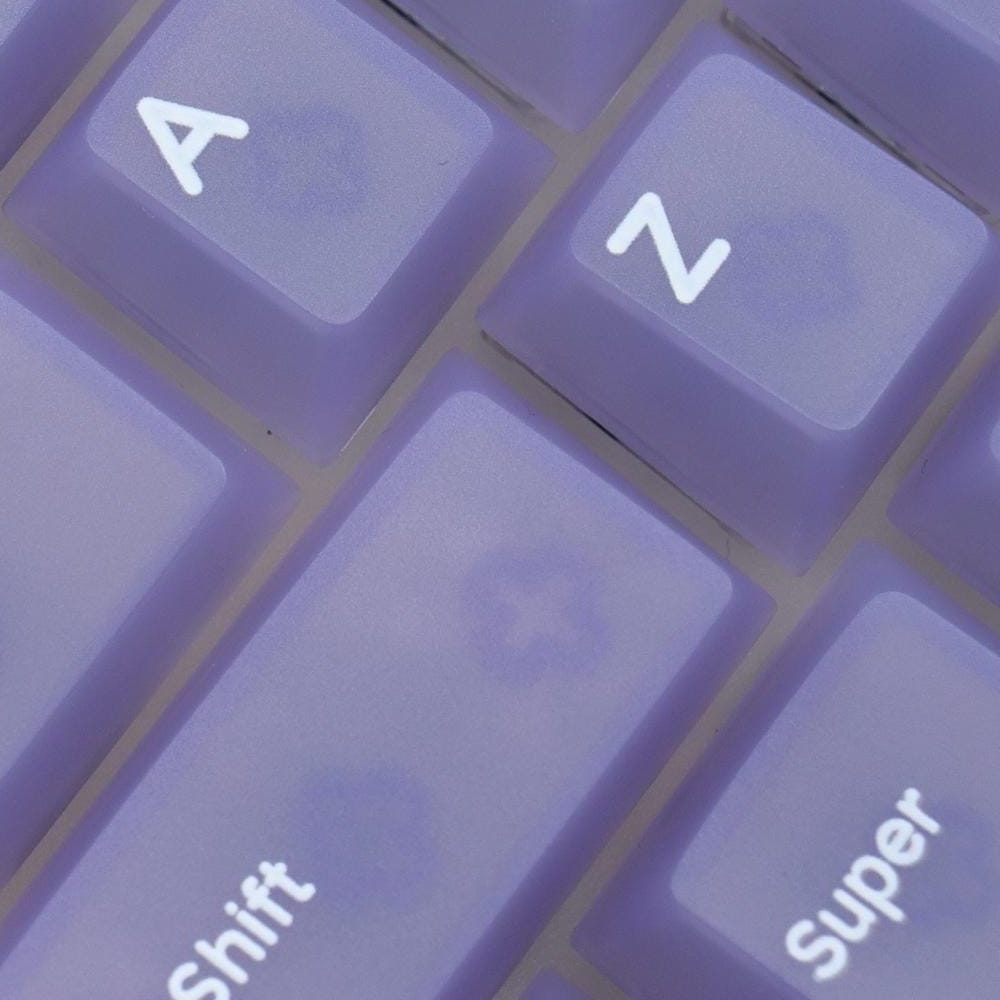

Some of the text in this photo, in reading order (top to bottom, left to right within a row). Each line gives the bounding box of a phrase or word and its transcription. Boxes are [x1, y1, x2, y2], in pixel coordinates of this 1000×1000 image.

[135, 96, 250, 196] A
[605, 191, 732, 304] Z
[167, 860, 317, 1000] Shift
[785, 787, 941, 981] Super
